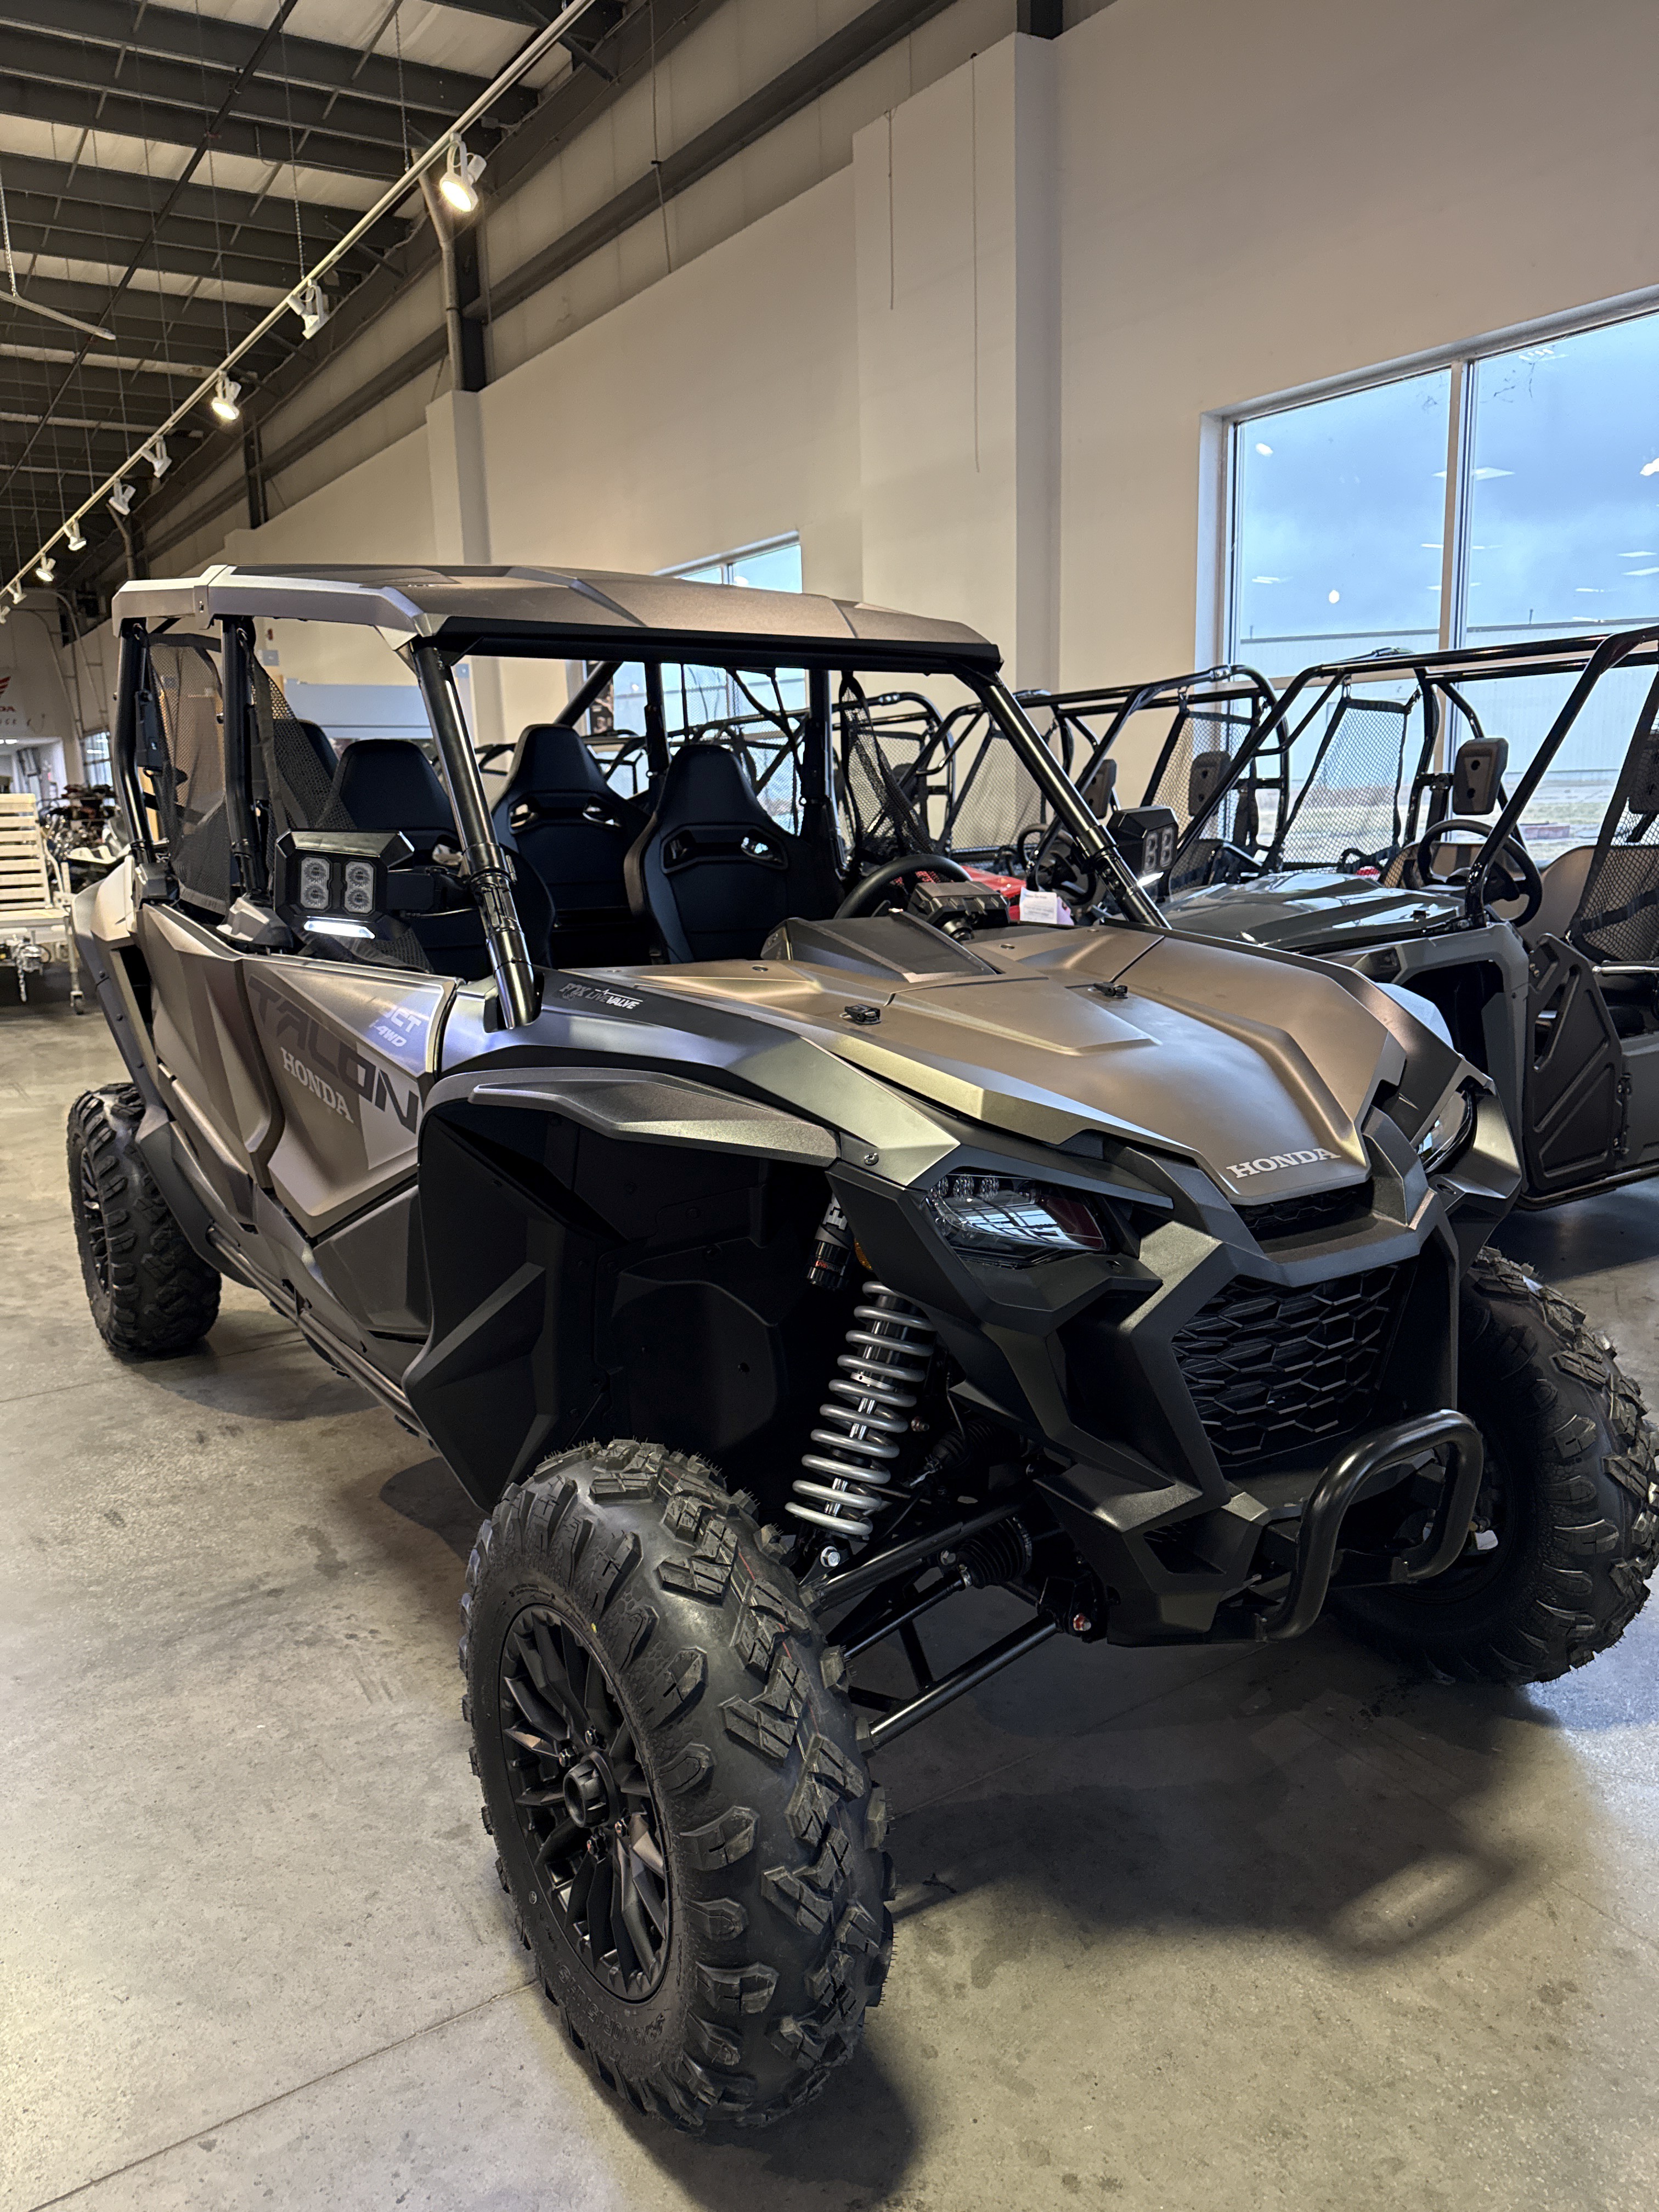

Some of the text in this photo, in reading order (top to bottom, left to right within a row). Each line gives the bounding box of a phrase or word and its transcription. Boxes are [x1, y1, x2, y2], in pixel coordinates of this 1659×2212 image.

[248, 975, 419, 1135] TALON
[281, 1047, 354, 1124] HONDA
[1226, 1148, 1342, 1178] HONDA
